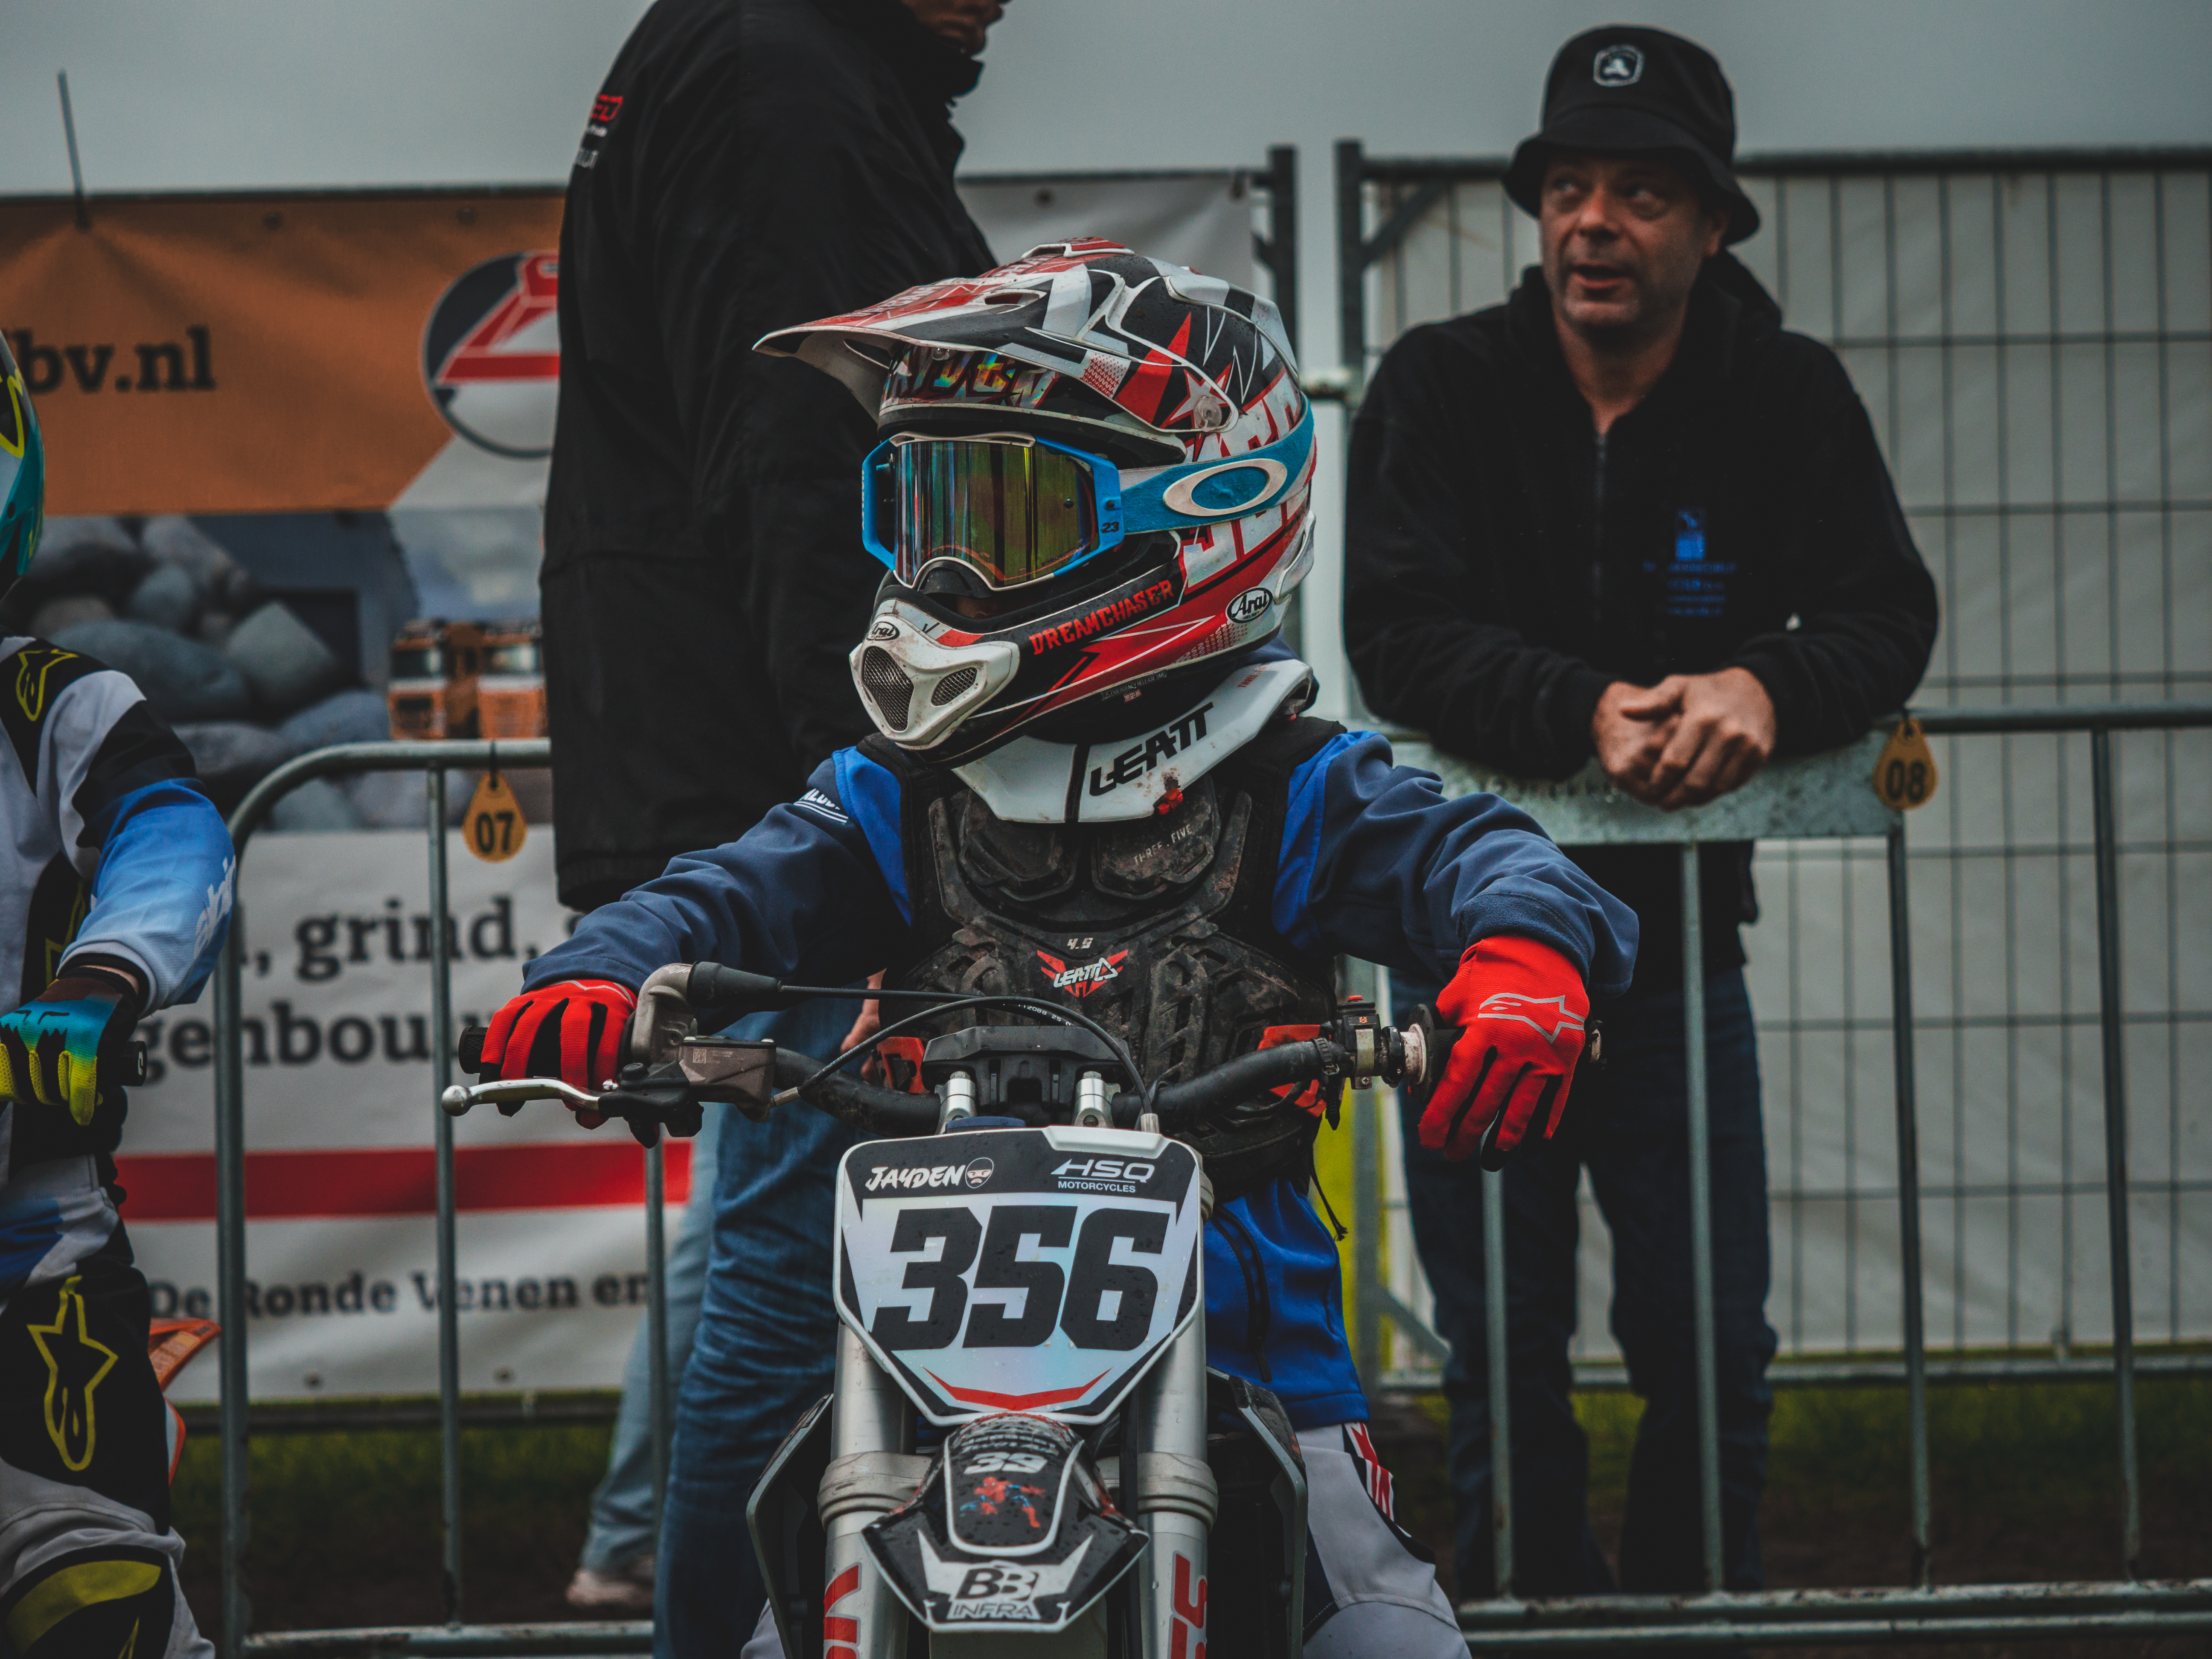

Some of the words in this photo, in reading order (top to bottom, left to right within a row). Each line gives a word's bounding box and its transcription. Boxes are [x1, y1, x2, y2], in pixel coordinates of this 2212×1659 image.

[0, 324, 216, 393] bv.nl
[1102, 521, 1120, 533] 23
[1029, 579, 1174, 655] DREAMCHASER
[1231, 589, 1268, 618] Arai
[1089, 702, 1214, 797] LEATT
[1886, 757, 1925, 803] 08
[476, 812, 515, 853] 07
[1133, 841, 1162, 866] THREE
[1170, 824, 1192, 844] FIVE
[294, 895, 539, 983] grind,
[1067, 937, 1094, 950] 4.5
[1053, 962, 1102, 988] LEATT
[865, 1164, 966, 1191] JAYDEN
[1050, 1158, 1155, 1183] HSQ
[1058, 1181, 1136, 1193] MOTORCYCLES
[869, 1205, 1171, 1351] 356
[952, 1602, 1033, 1617] INFRA
